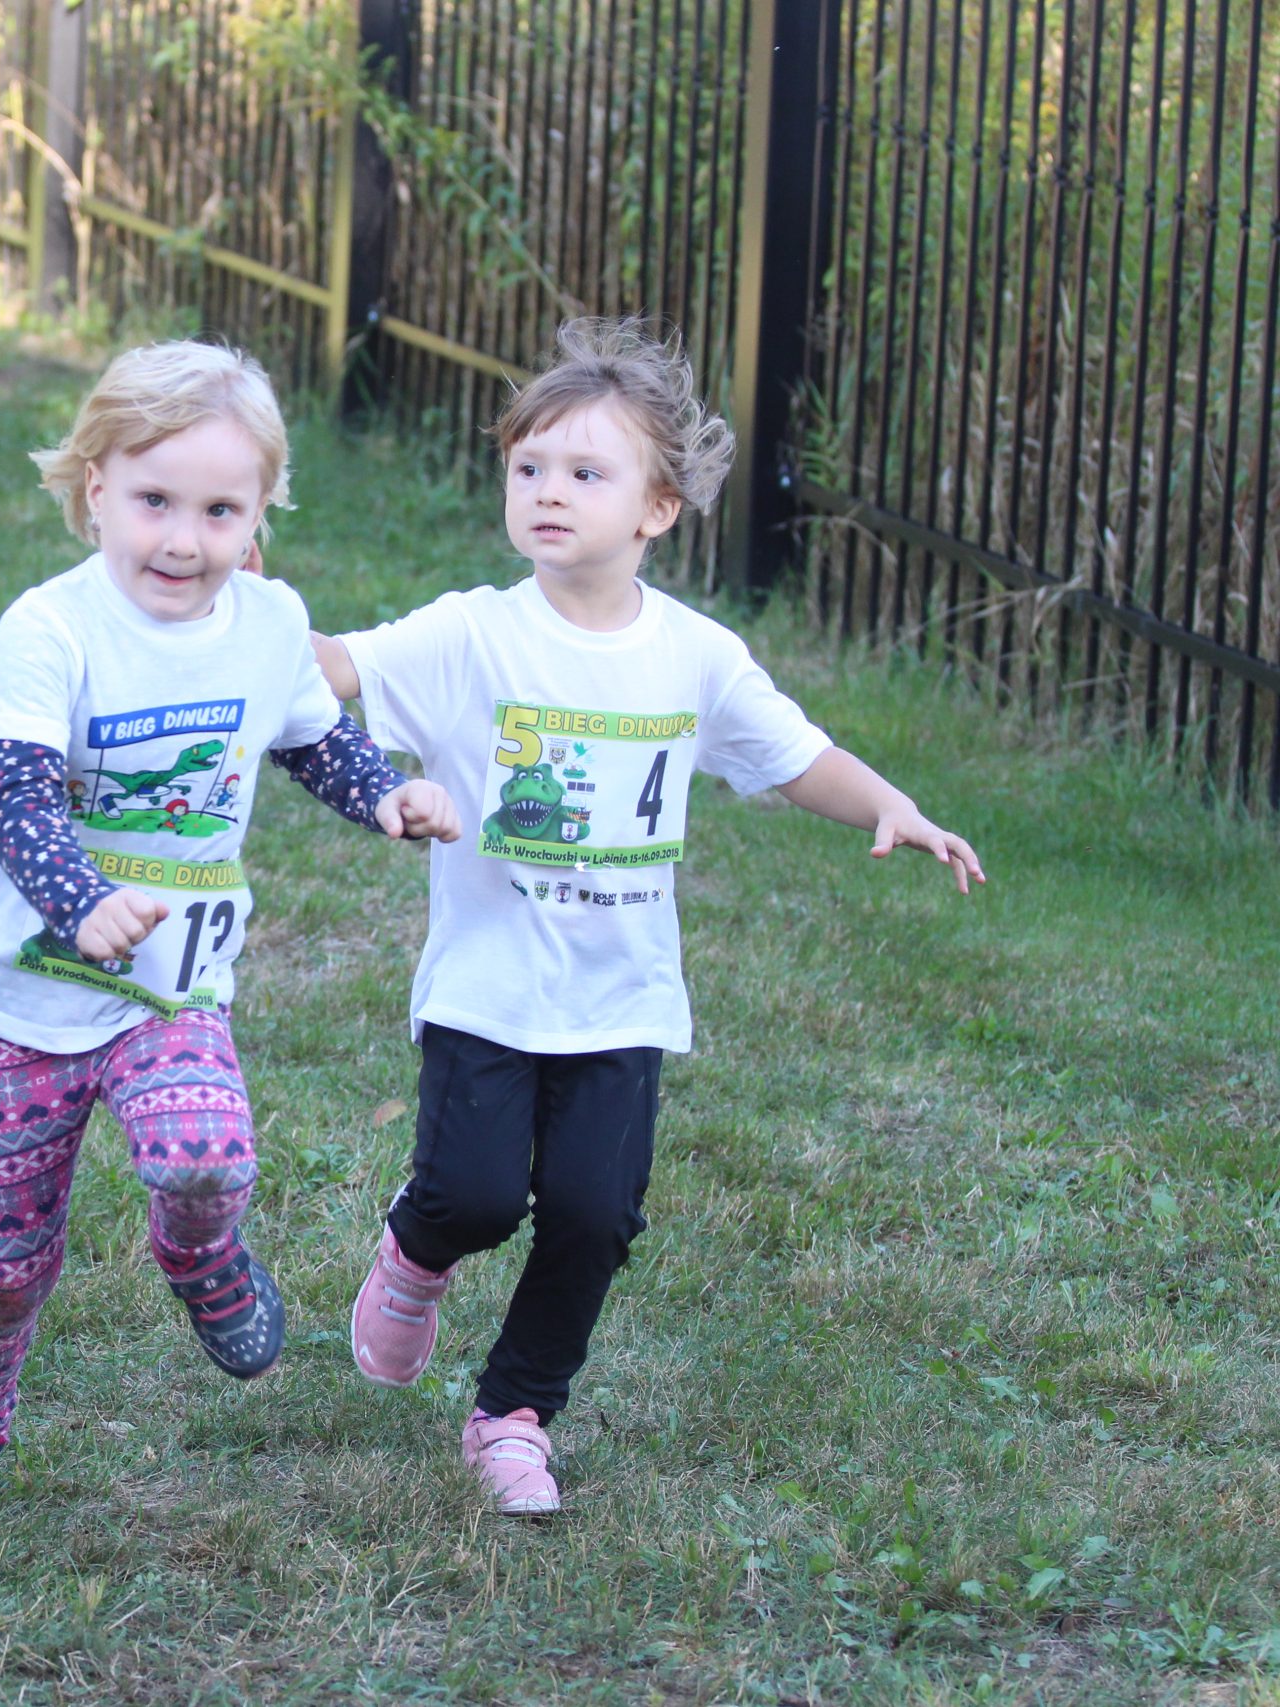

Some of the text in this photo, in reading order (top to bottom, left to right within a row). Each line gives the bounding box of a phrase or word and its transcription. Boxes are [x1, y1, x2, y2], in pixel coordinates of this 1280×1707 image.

[100, 705, 238, 742] V BIEG DINUSIA
[495, 705, 543, 769] 5
[544, 709, 607, 735] BIEG
[636, 749, 669, 837] 4
[100, 852, 164, 882] BIEG
[483, 841, 511, 856] Park
[514, 845, 578, 863] Wrocławski
[593, 853, 628, 865] Lubinie
[630, 847, 680, 864] 15-16.09.2018
[593, 892, 617, 900] DOLNY
[19, 958, 48, 973] Park
[52, 964, 118, 991] Wrocławski
